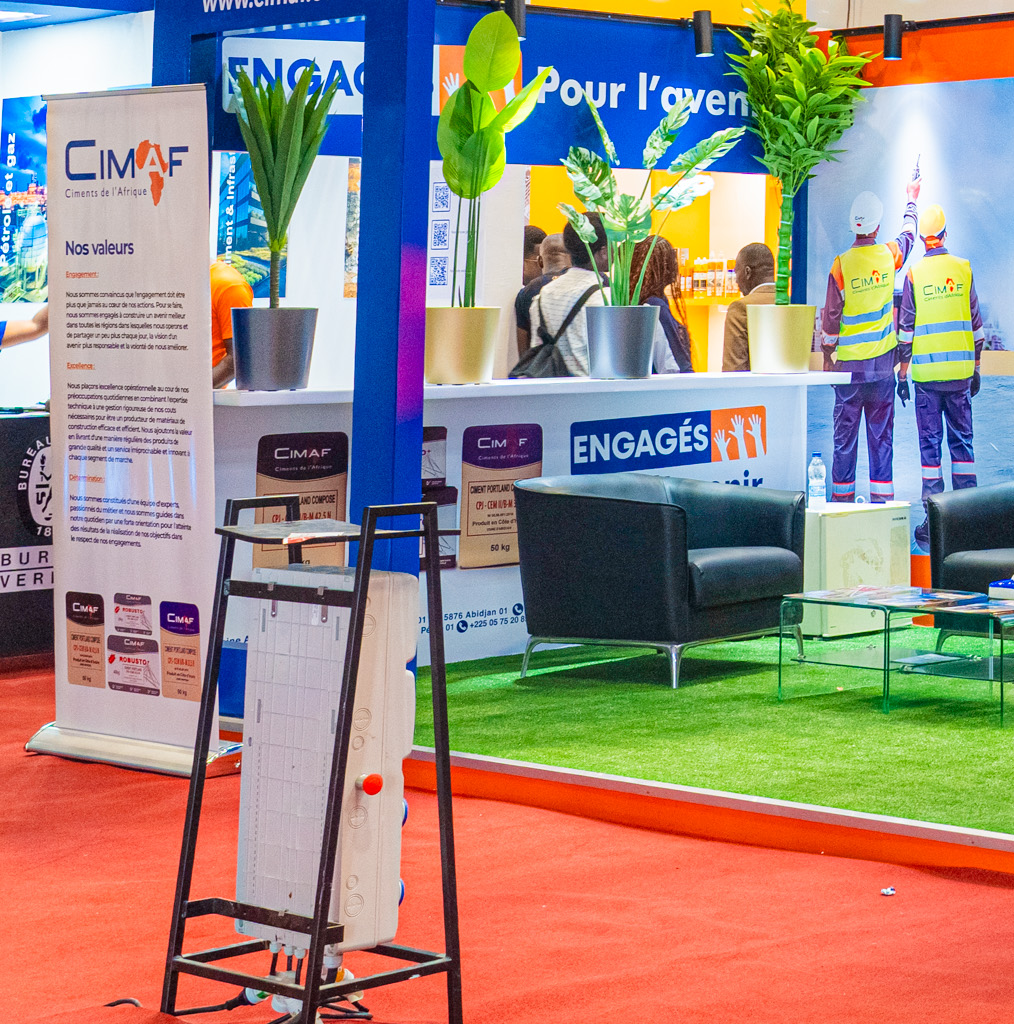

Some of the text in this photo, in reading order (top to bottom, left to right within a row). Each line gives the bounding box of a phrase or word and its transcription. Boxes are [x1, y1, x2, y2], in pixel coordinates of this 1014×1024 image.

[537, 66, 629, 109] Pour
[7, 132, 16, 167] gaz
[65, 139, 189, 181] CIMAF
[5, 173, 13, 192] et
[65, 186, 147, 199] Ciments de l'Afrique
[65, 239, 134, 256] Nos valeurs
[573, 418, 709, 464] ENGAGÉS
[274, 447, 331, 460] CIMAF
[470, 484, 510, 494] CIMENT PORTLAND
[312, 494, 335, 505] COMPOSE
[475, 501, 484, 510] CPJ
[487, 500, 497, 510] CEM
[490, 544, 510, 552] 50 kg
[73, 602, 98, 614] CIMAF
[444, 607, 508, 621] 5876 Abidjan 01
[167, 613, 195, 625] CIMAF
[470, 619, 488, 629] +225
[489, 618, 498, 626] 05
[500, 617, 509, 625] 75
[510, 616, 519, 624] 20
[124, 638, 145, 647] CIMAF
